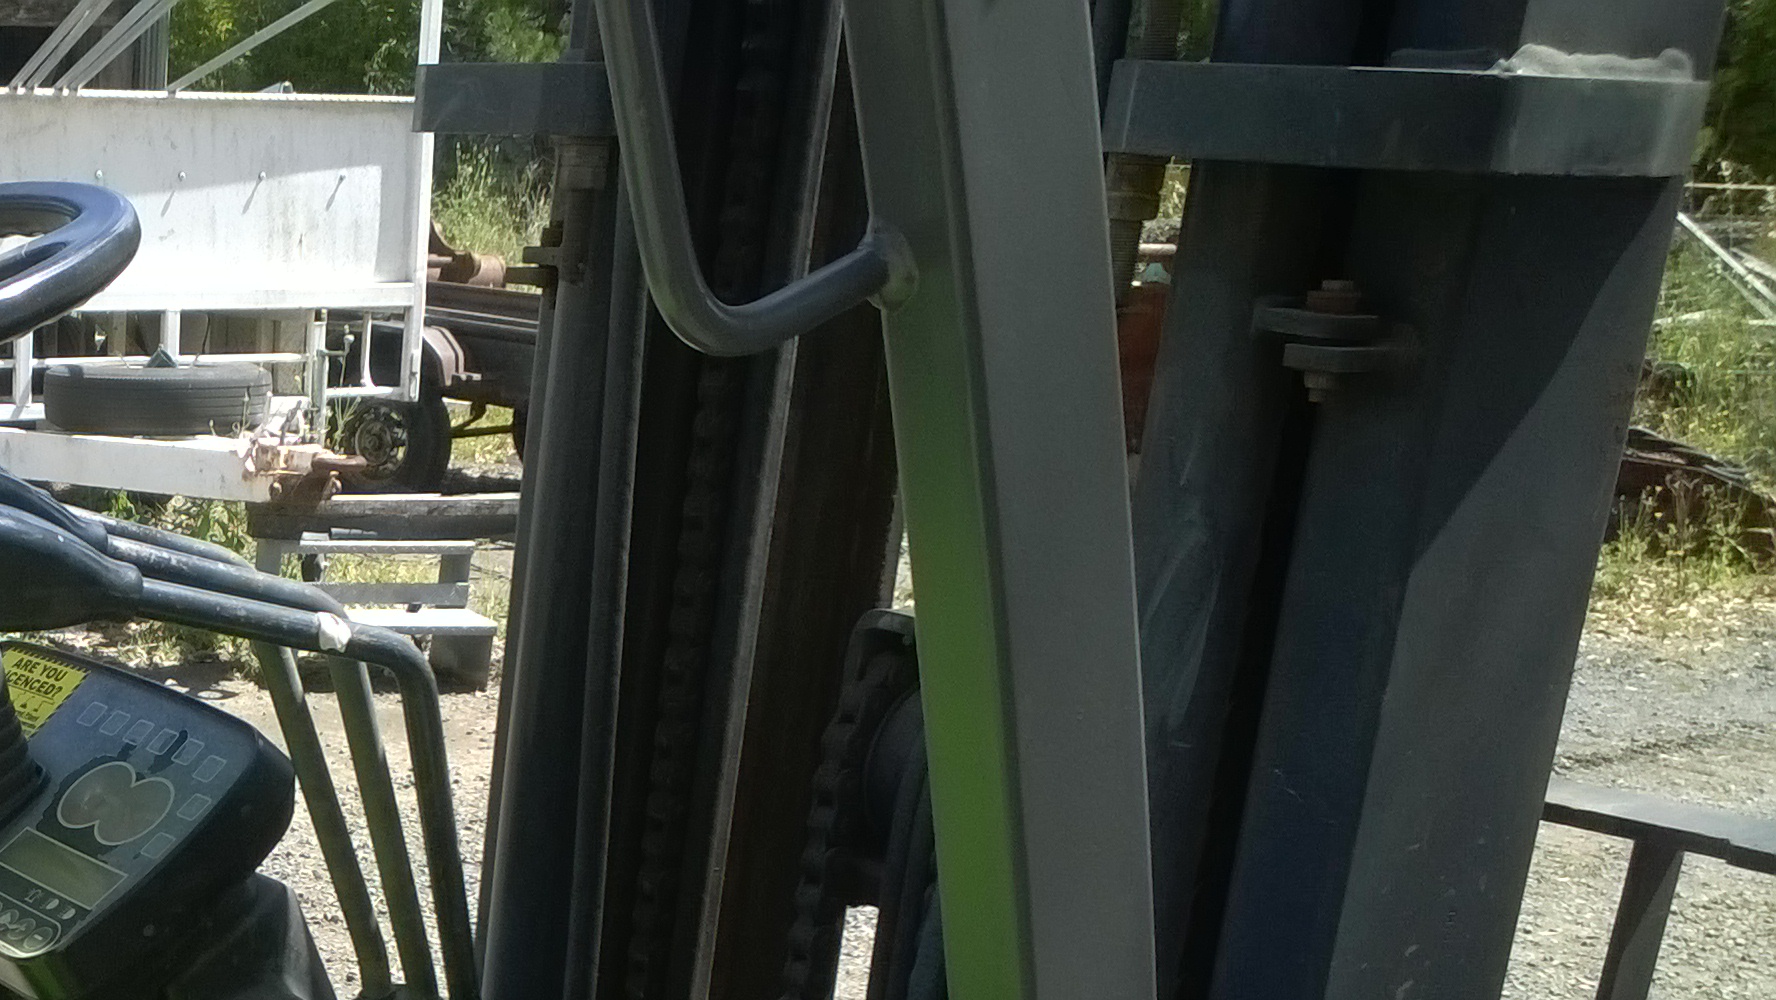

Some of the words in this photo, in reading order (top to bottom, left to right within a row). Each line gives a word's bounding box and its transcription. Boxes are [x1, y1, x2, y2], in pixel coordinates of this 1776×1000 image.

[11, 657, 41, 674] ARE
[39, 664, 68, 682] YOU
[6, 669, 63, 697] ICENCED?
